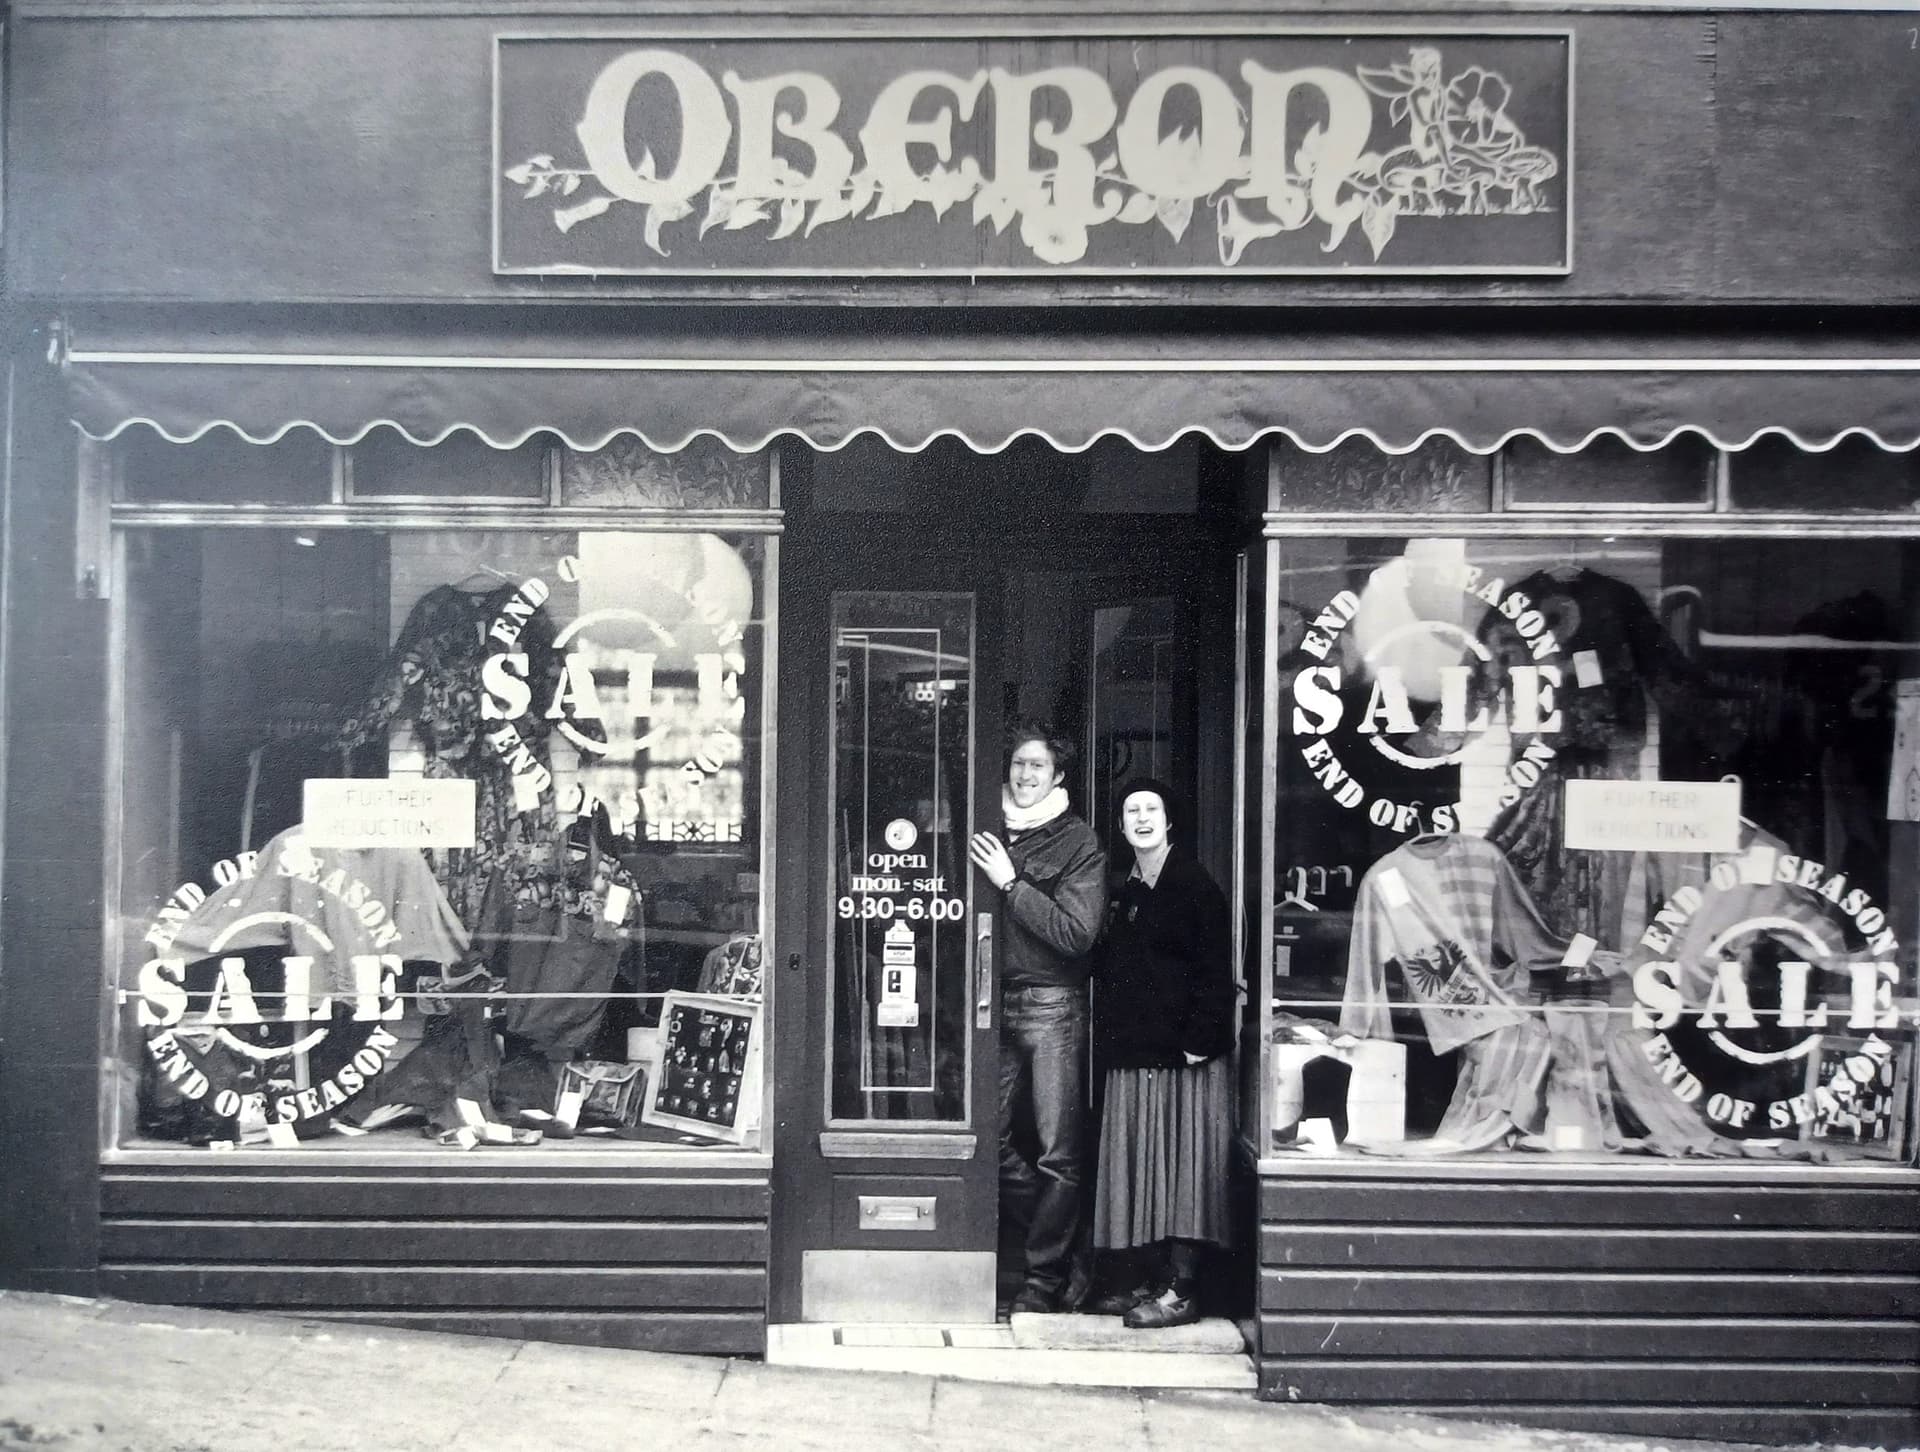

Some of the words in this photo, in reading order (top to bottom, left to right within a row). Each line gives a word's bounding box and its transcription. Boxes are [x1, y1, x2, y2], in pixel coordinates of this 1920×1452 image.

[575, 49, 1375, 220] OBERON
[489, 577, 549, 645] END
[1300, 590, 1360, 660] END
[481, 652, 745, 720] SALE
[1293, 665, 1562, 735] SALE
[487, 723, 551, 793] END
[1302, 738, 1364, 808] END
[1369, 798, 1418, 833] OF
[868, 853, 928, 873] open
[145, 882, 206, 950] END
[213, 850, 258, 888] OF
[838, 896, 964, 920] 9.30-6.00
[1641, 886, 1702, 954] END
[1777, 854, 1899, 956] SEASON
[138, 954, 404, 1027] SALE
[1632, 961, 1899, 1029] SALE
[148, 1032, 209, 1099] END
[214, 1088, 267, 1122] OF
[276, 1025, 399, 1123] SEASON
[1641, 1032, 1702, 1102] END
[1707, 1092, 1756, 1128] OF
